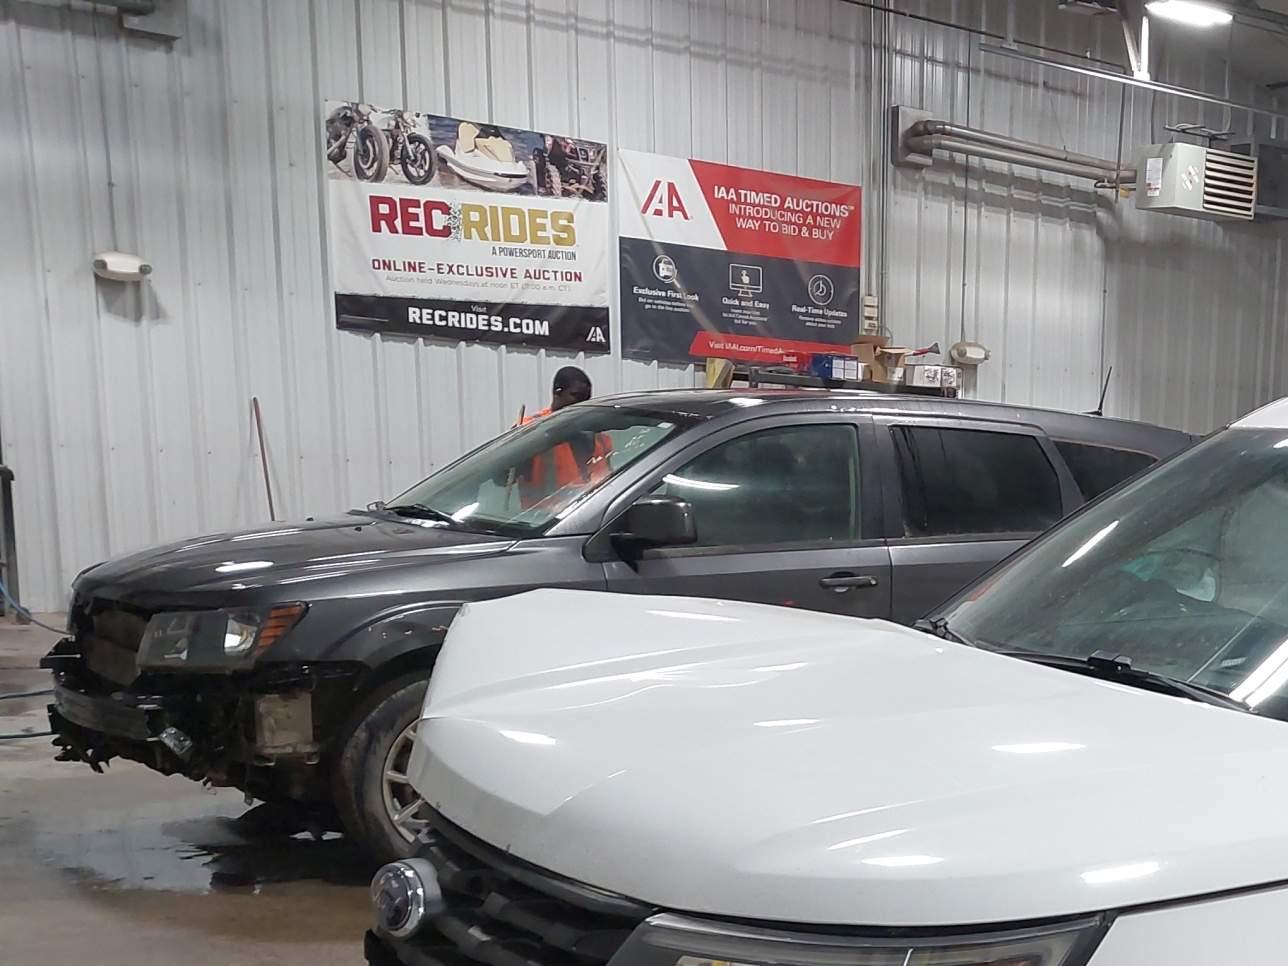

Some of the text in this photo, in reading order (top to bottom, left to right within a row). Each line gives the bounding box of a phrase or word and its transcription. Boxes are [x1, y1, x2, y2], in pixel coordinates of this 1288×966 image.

[713, 185, 737, 201] IAA
[738, 189, 781, 208] TIMED
[369, 195, 577, 247] REC RIDES
[729, 203, 841, 229] INTRODUCING A NEW
[736, 217, 834, 240] WAY TO BID & BUY
[491, 246, 577, 260] A POWERSPORT AUCTION
[371, 258, 582, 282] ONLINE-EXCLUSIVE AUCTION
[470, 304, 487, 313] Visit
[407, 306, 550, 336] RECRIDES.COM
